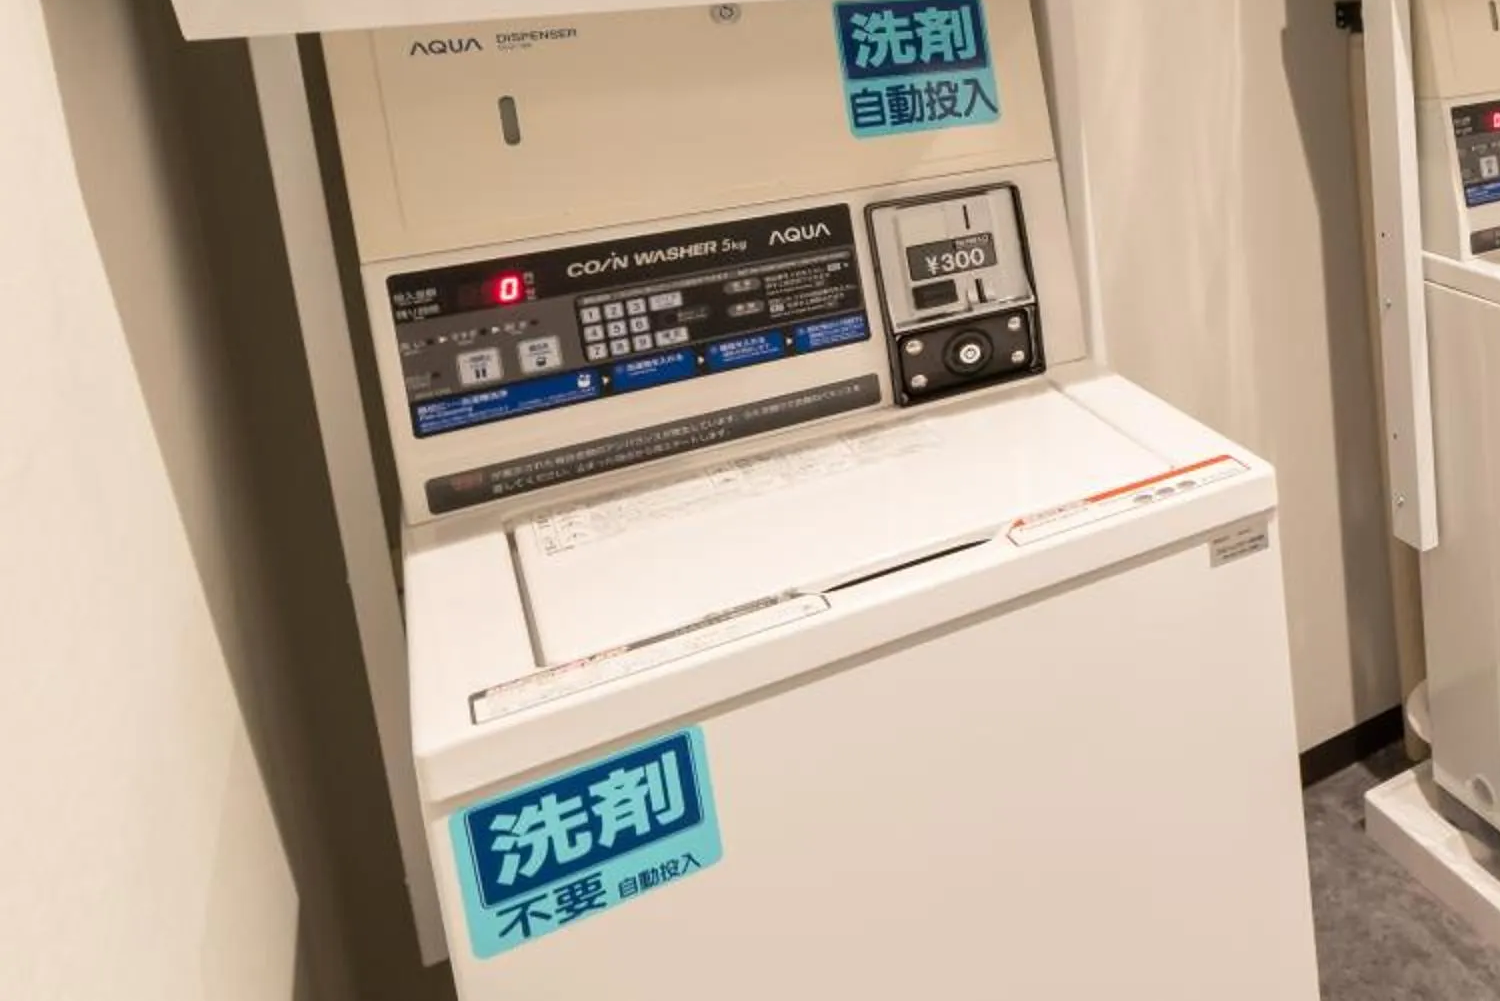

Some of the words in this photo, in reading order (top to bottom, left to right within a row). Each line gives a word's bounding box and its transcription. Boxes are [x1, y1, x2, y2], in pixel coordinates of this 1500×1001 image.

[410, 38, 483, 56] AQUA
[496, 28, 577, 44] DISPENSER
[851, 5, 977, 68] 洗剤
[850, 78, 999, 128] 自動投入
[769, 223, 831, 246] AQUA
[634, 240, 717, 266] WASHER
[925, 247, 985, 275] ¥300
[500, 276, 518, 301] 0
[489, 750, 686, 887] 洗剤
[495, 871, 608, 939] 不要
[618, 853, 702, 899] 自動投入
